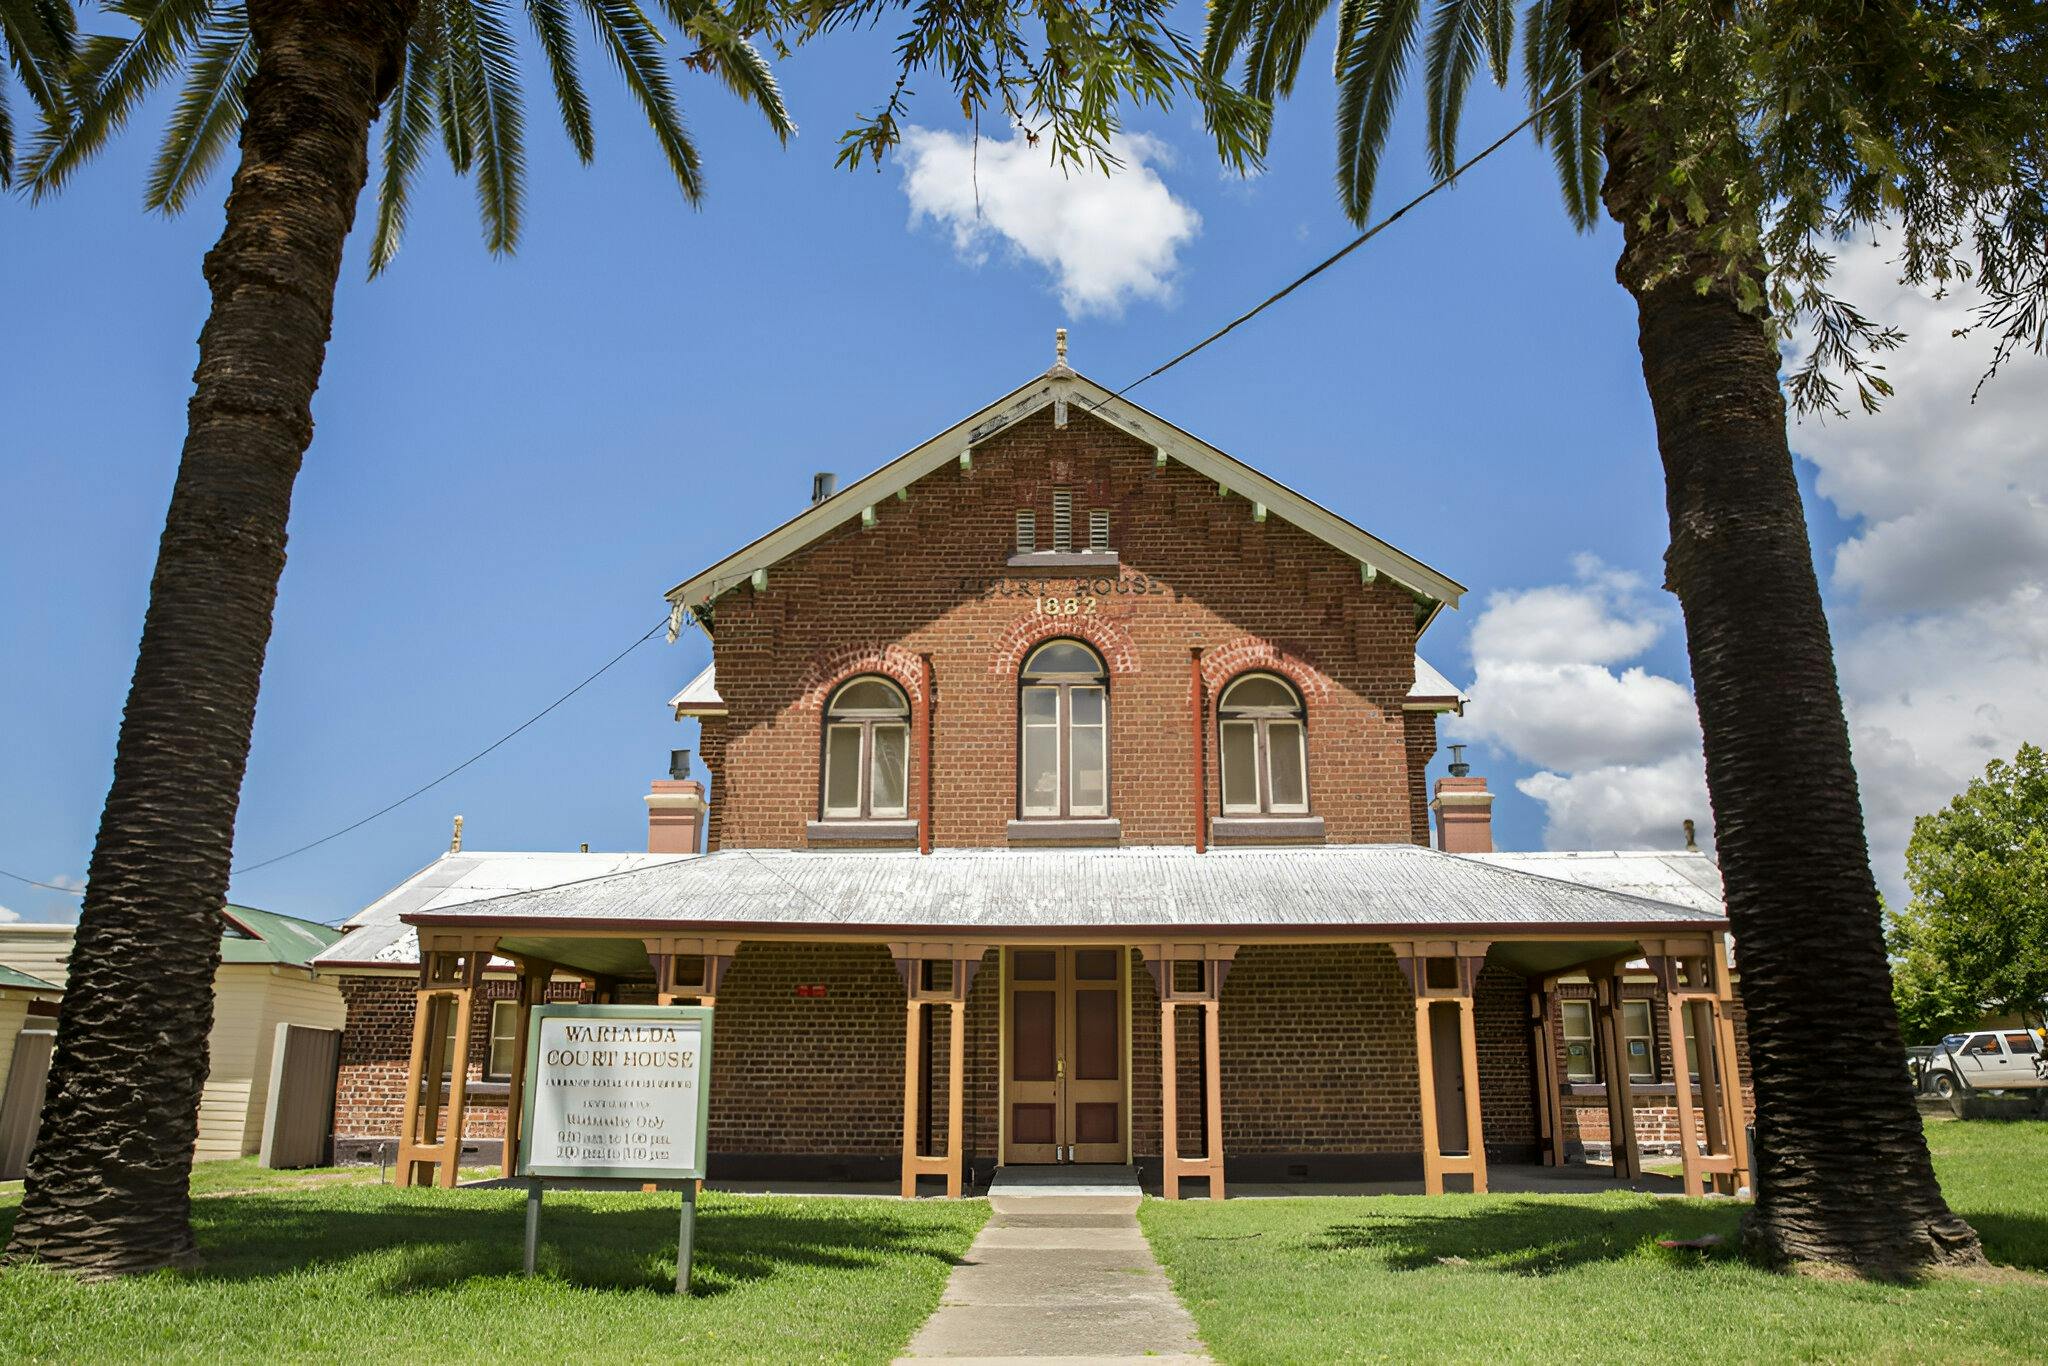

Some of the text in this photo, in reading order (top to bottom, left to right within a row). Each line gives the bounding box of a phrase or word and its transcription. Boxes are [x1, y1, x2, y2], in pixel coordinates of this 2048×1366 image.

[1035, 598, 1097, 615] 1882
[566, 1025, 677, 1043] WARIALDA
[547, 1050, 693, 1068] COURT HOUSE
